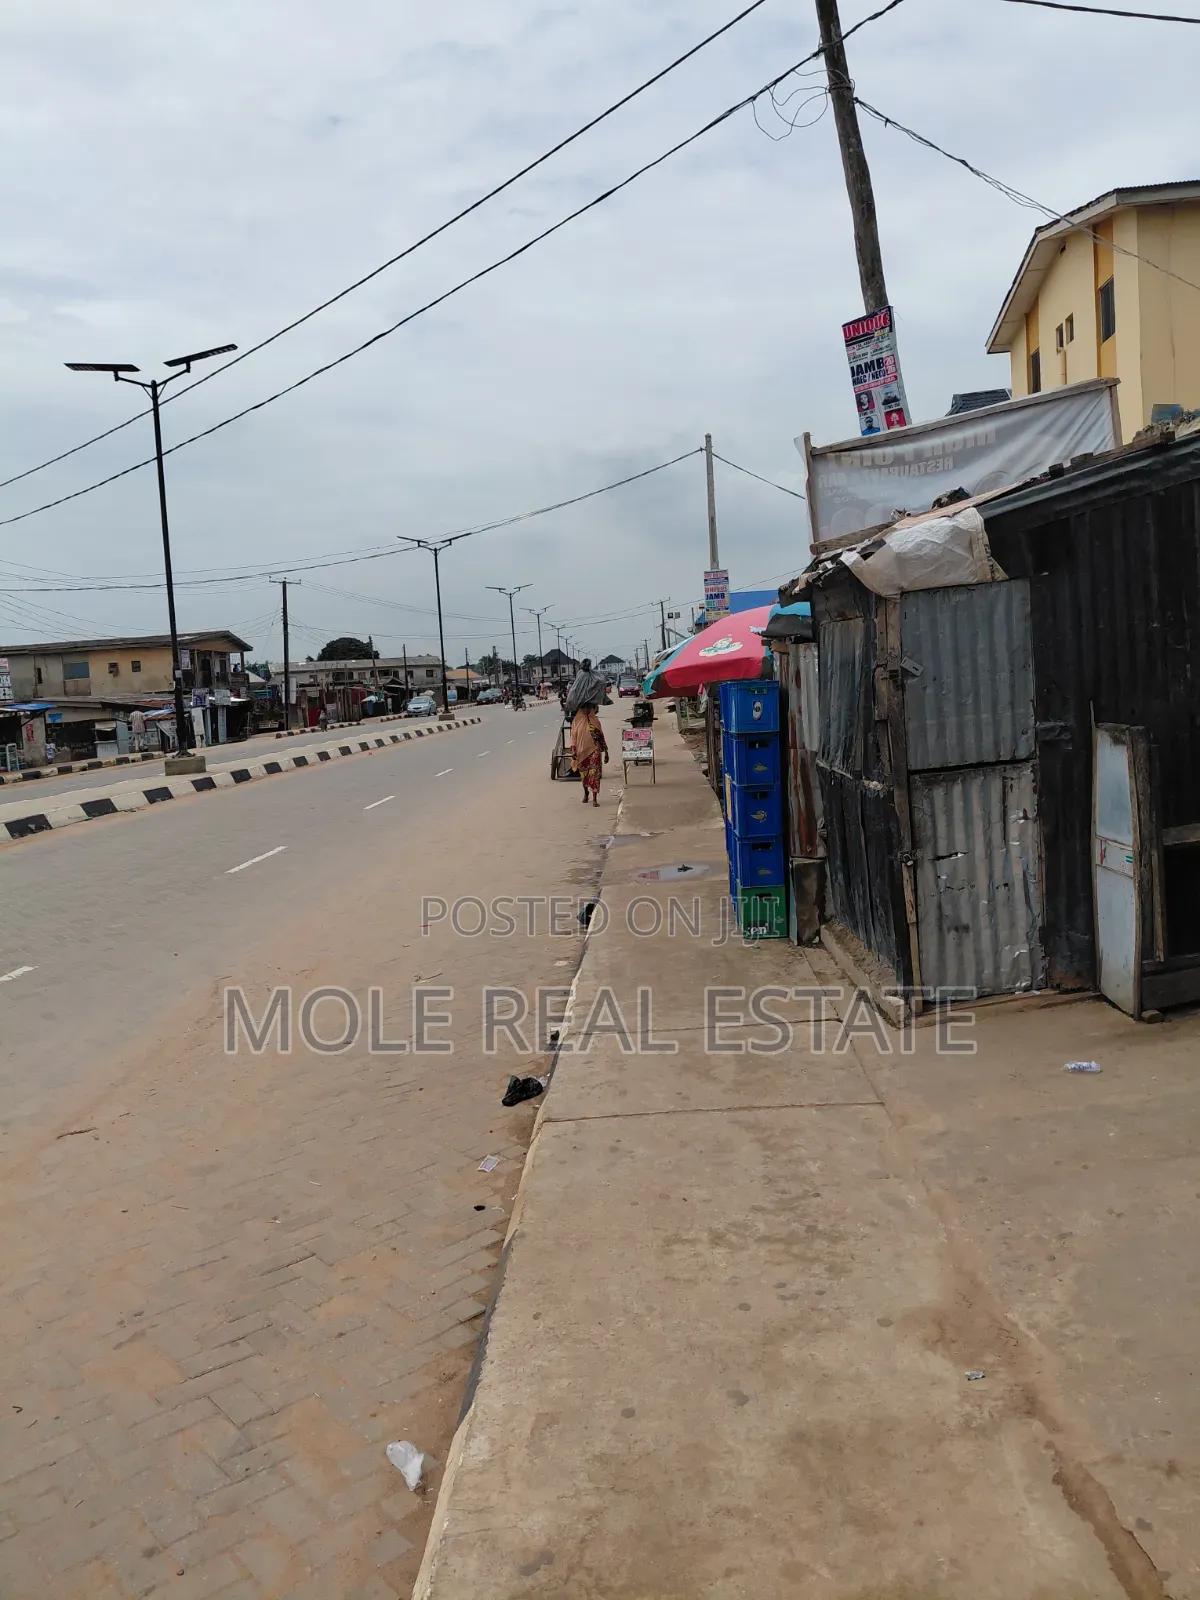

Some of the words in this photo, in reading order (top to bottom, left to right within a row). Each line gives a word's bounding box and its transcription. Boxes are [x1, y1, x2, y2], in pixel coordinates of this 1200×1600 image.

[843, 312, 889, 340] UNIQUE
[850, 357, 885, 378] JAMB
[705, 592, 726, 601] JAMB
[624, 729, 651, 741] POS
